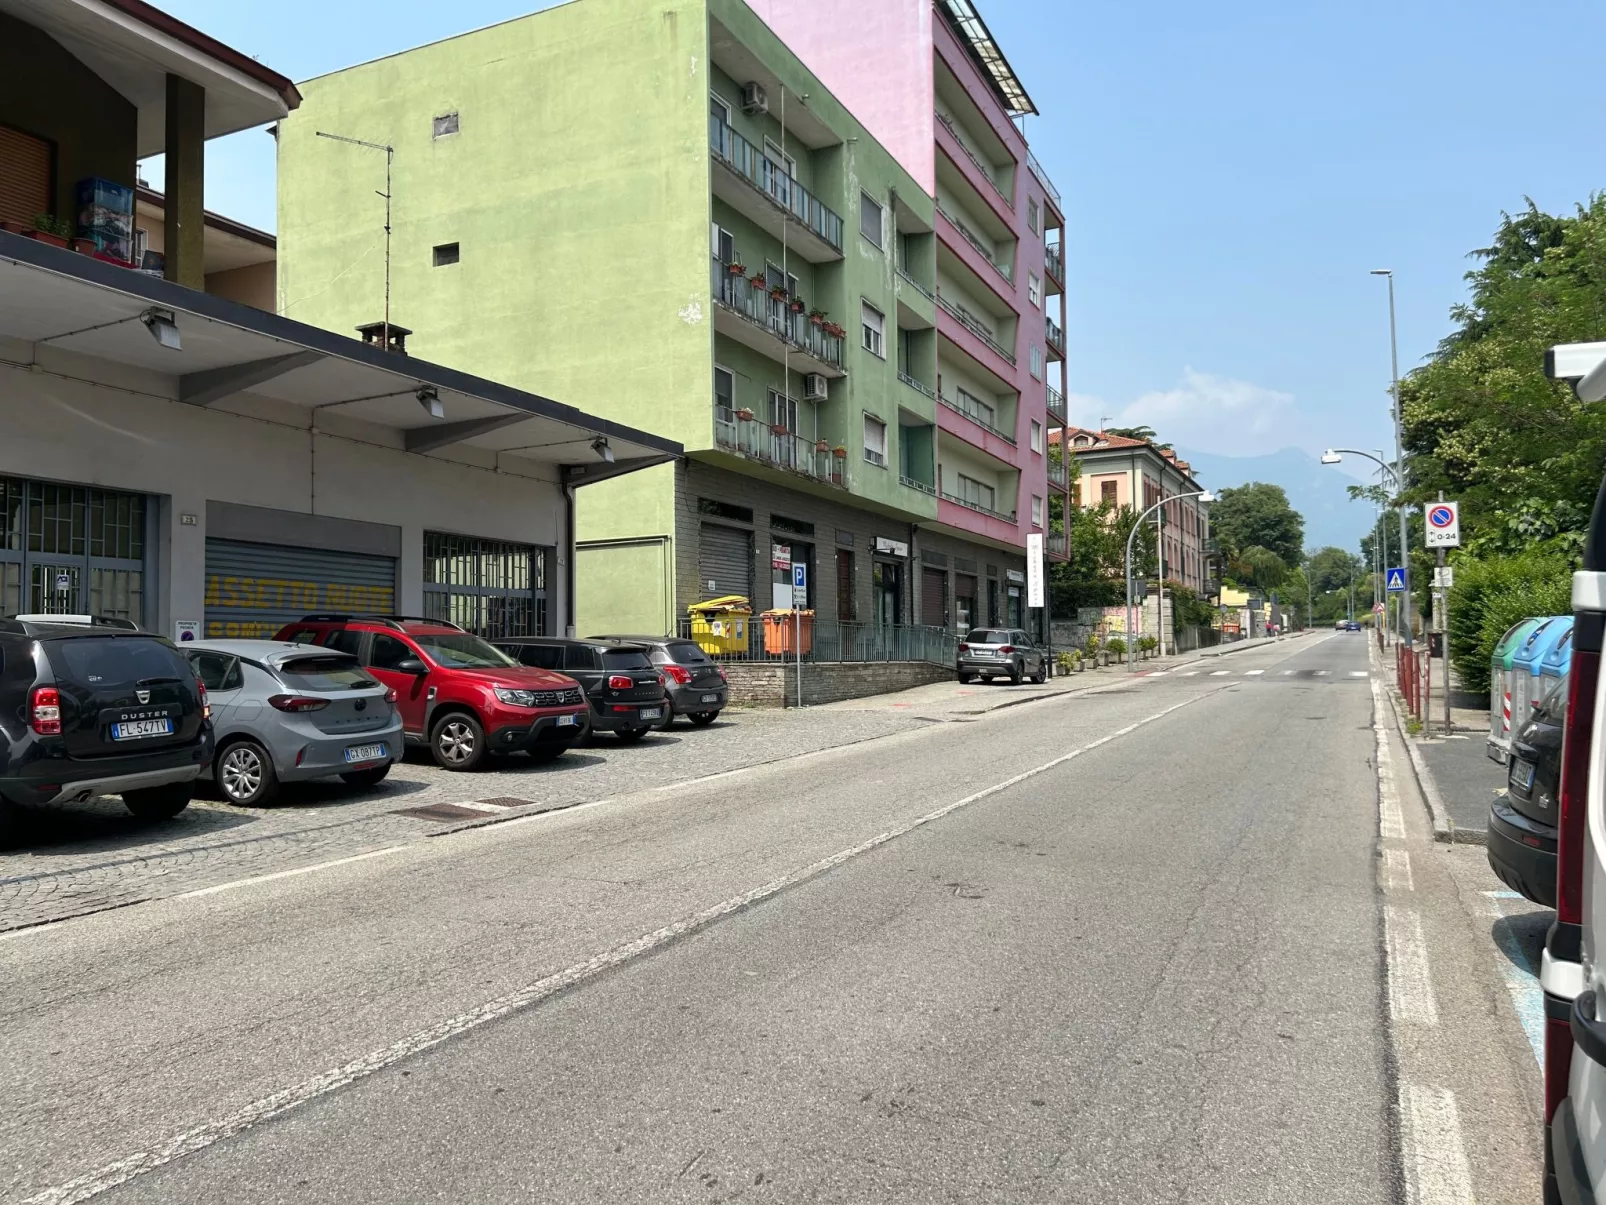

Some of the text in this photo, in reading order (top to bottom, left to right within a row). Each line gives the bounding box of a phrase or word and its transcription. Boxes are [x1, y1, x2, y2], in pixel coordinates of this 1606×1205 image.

[795, 568, 803, 584] P
[203, 575, 317, 611] ASSETTO
[121, 711, 168, 720] DUSTER
